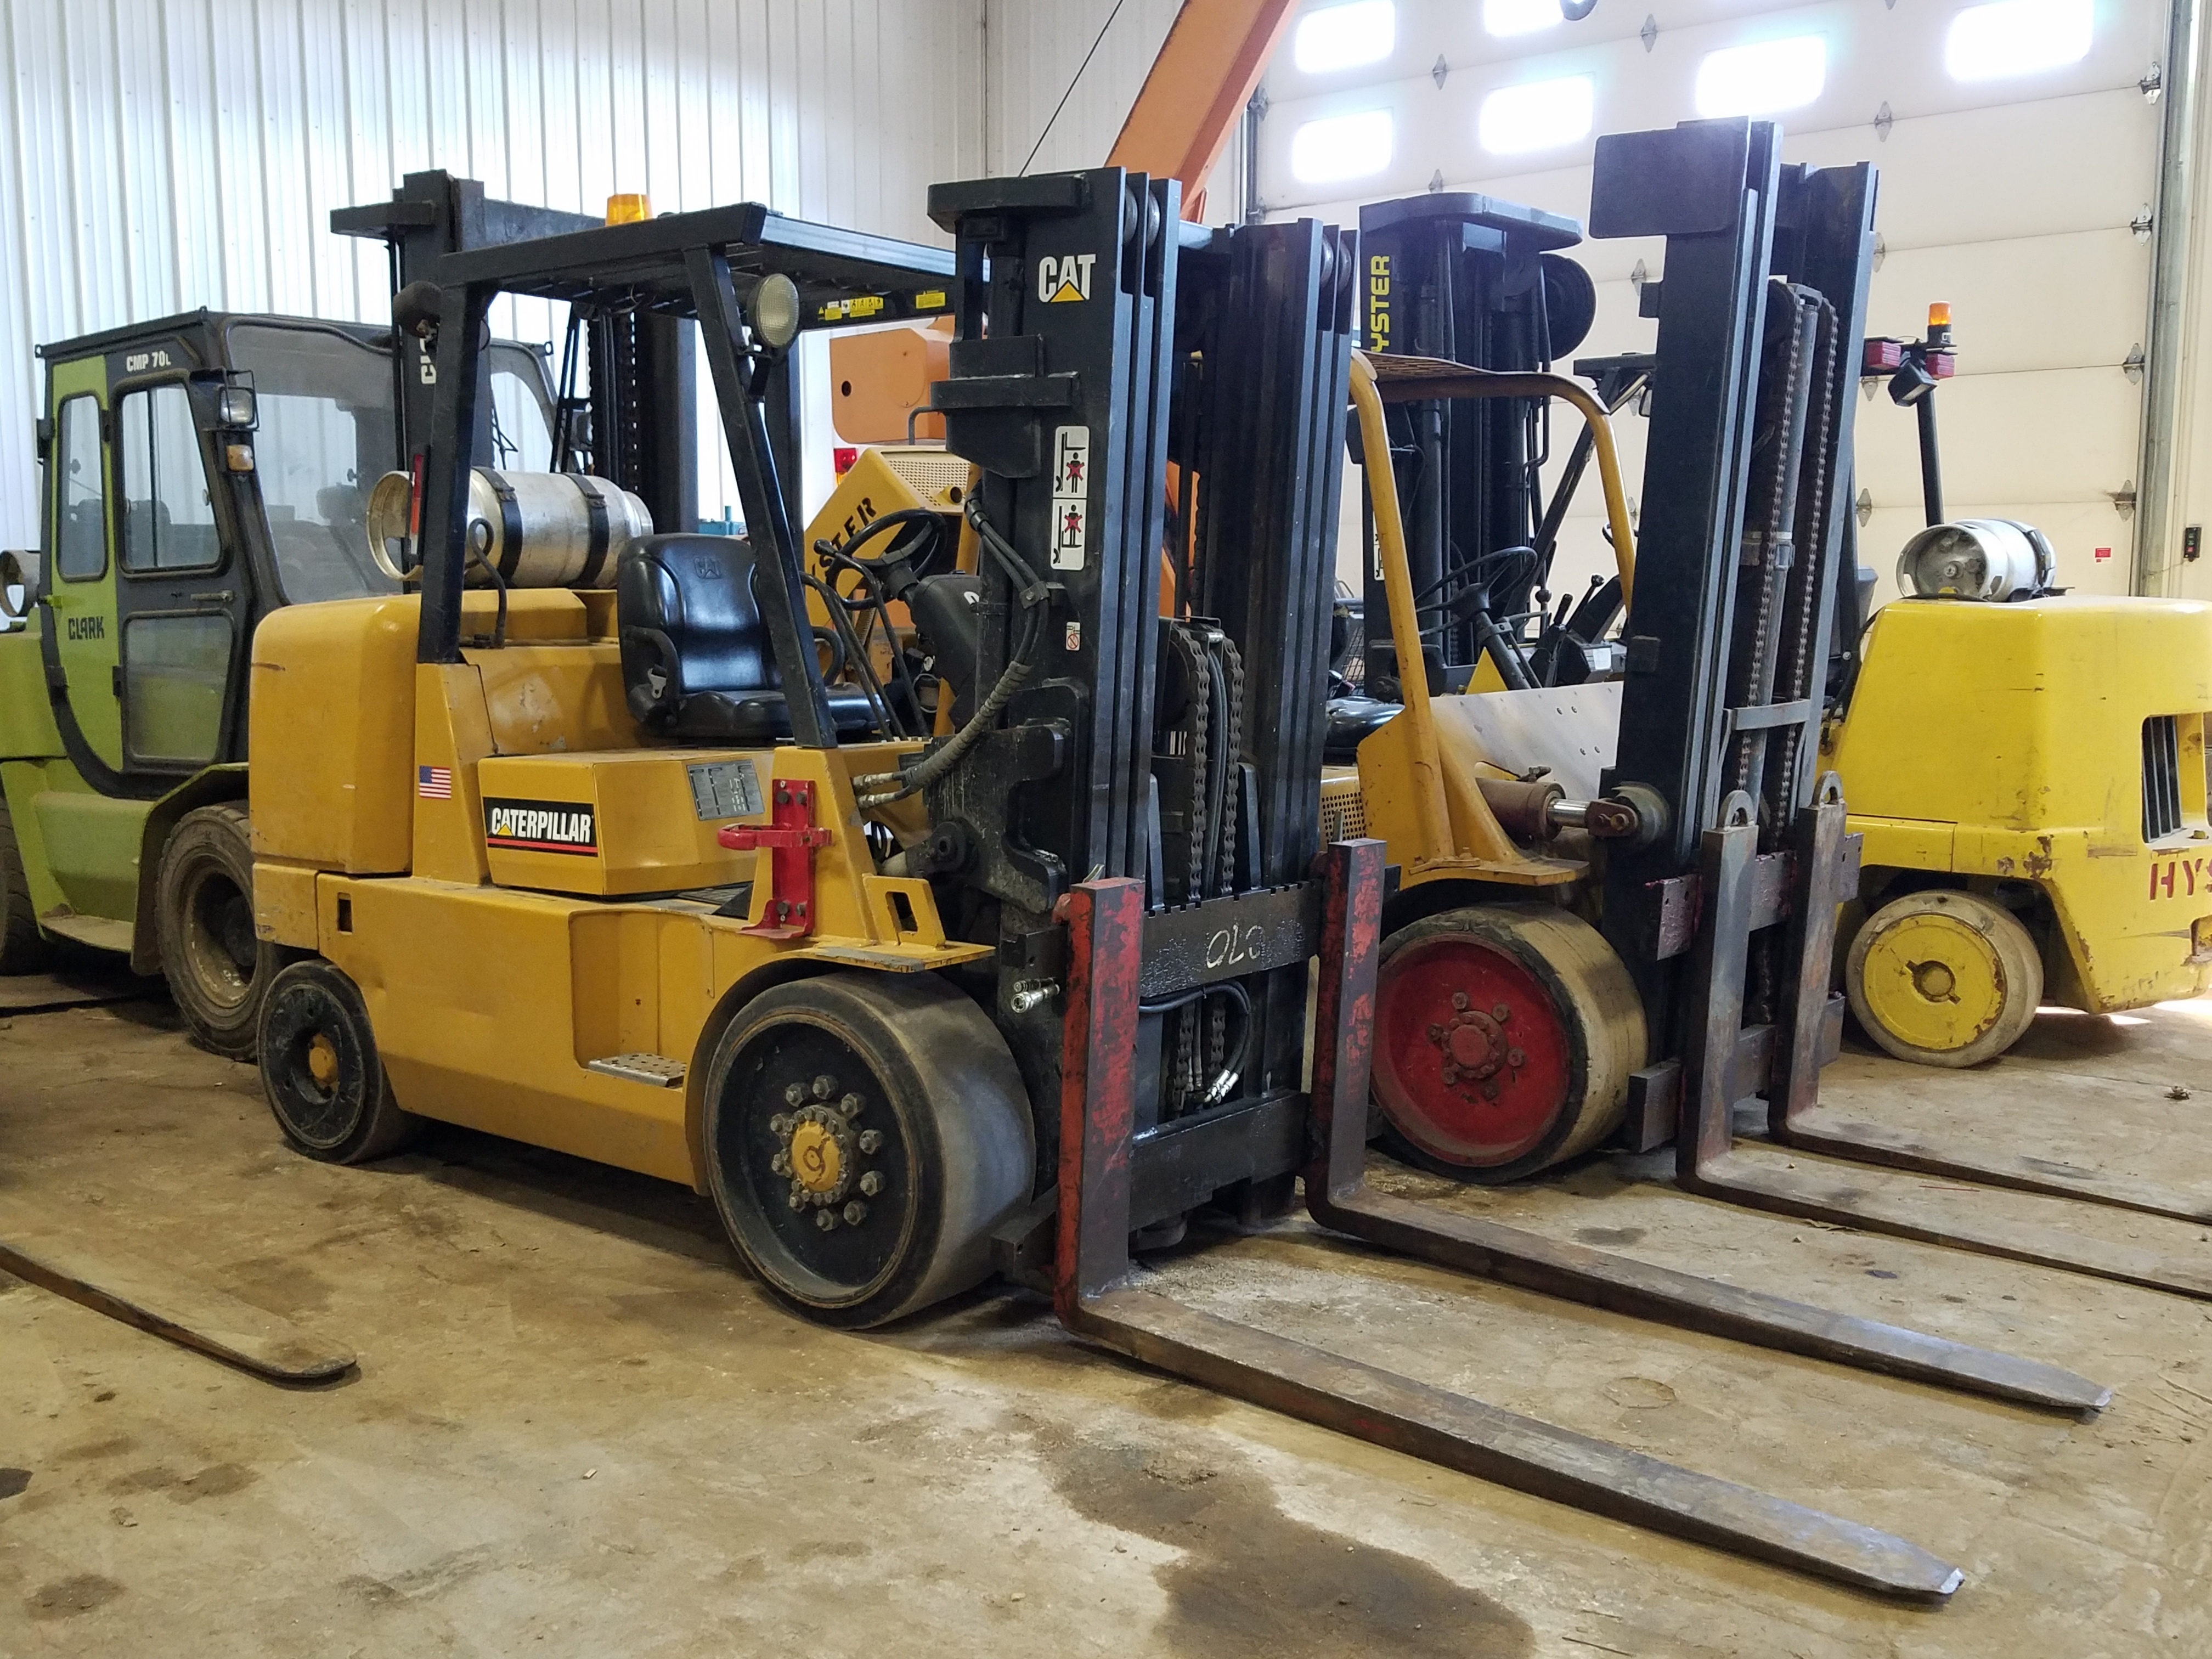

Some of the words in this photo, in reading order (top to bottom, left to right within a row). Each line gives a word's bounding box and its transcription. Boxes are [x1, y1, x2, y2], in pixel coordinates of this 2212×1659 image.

[1038, 253, 1096, 303] CAT
[126, 353, 149, 372] CMP
[151, 351, 171, 368] 70L
[68, 616, 105, 640] CLARK
[492, 807, 591, 843] CATERPILLAR
